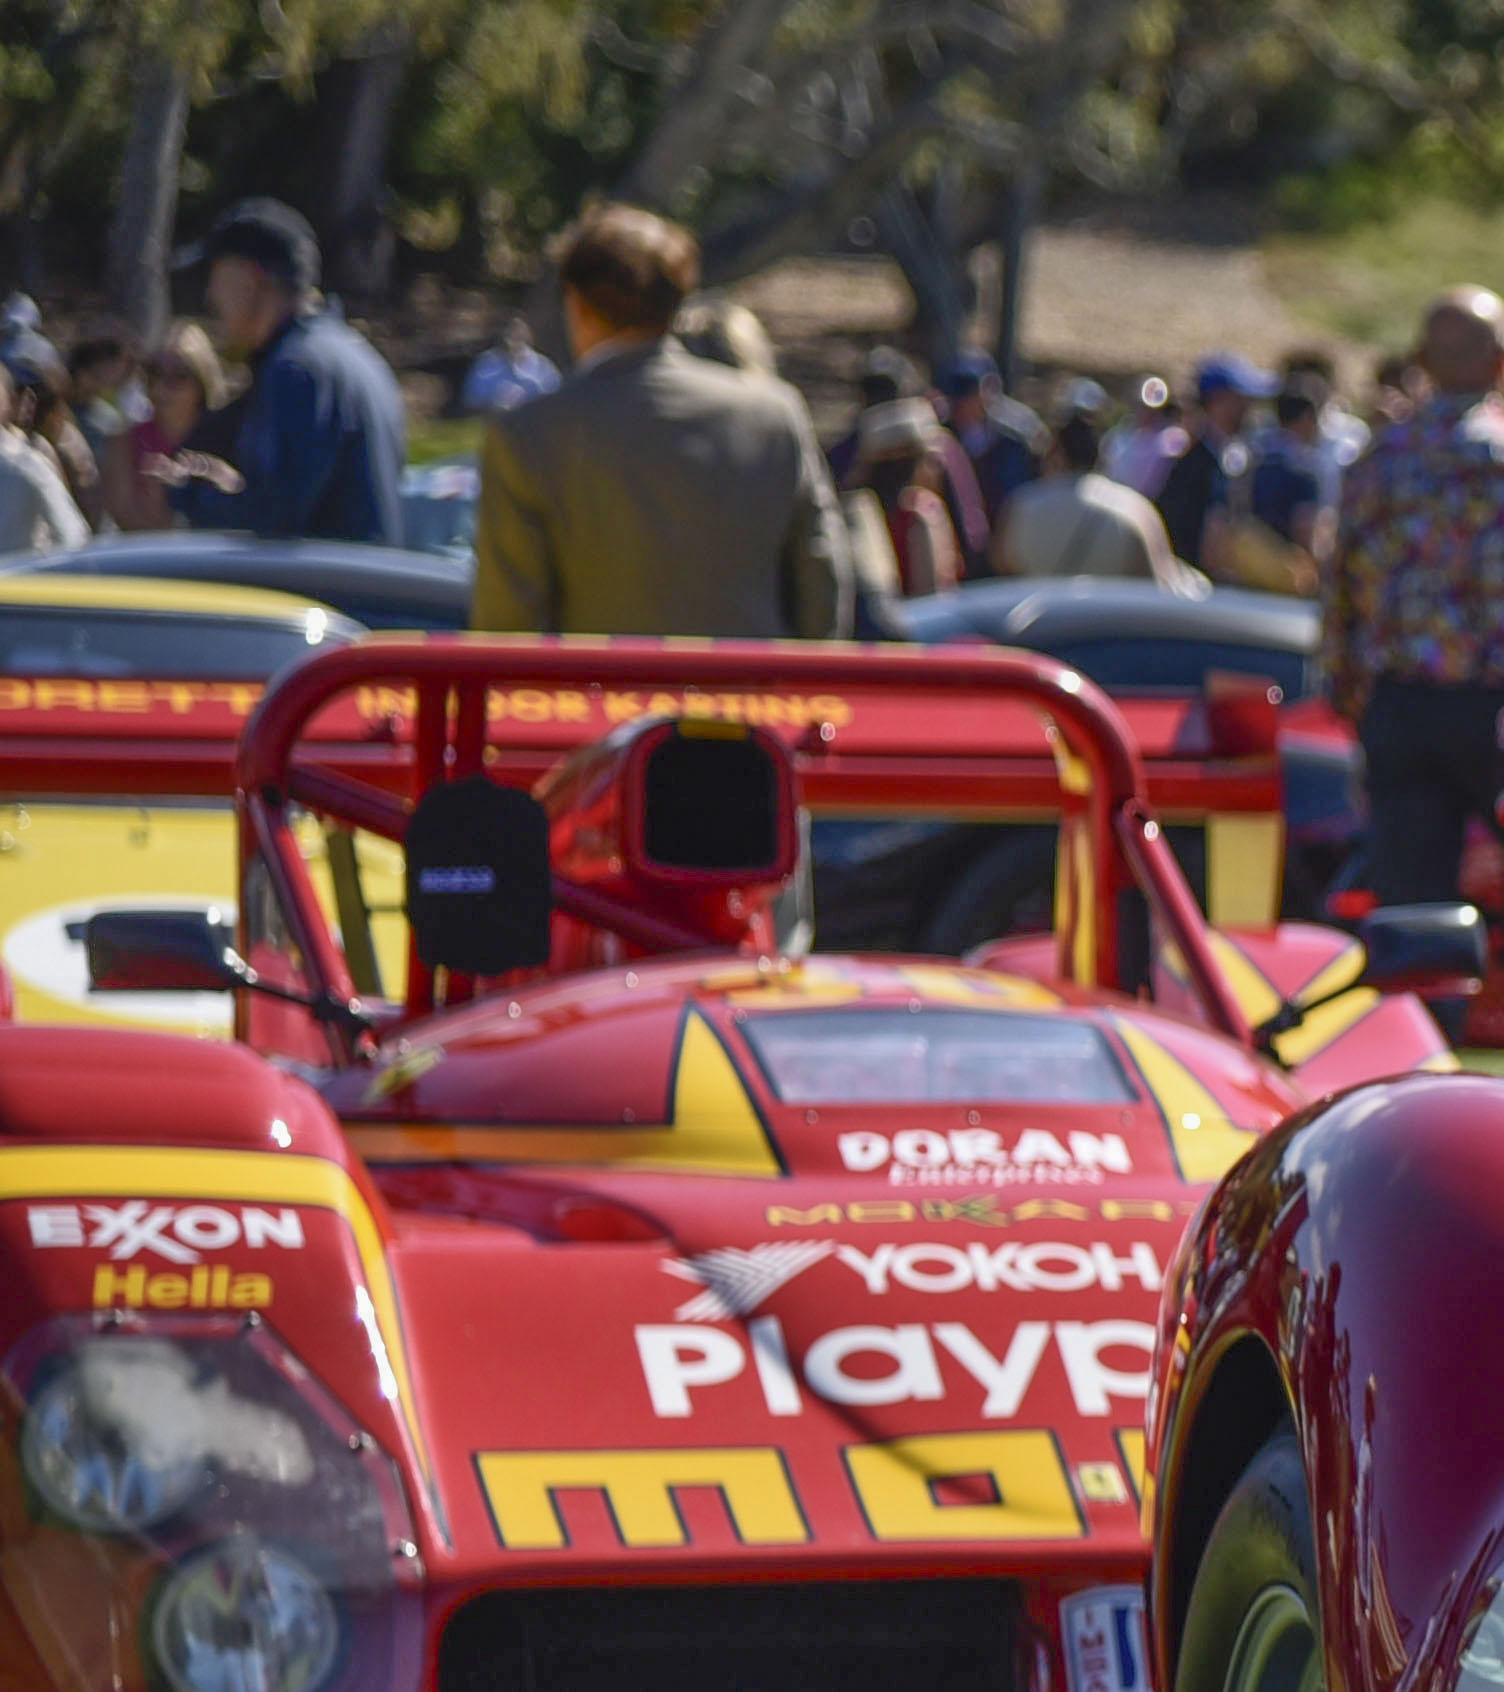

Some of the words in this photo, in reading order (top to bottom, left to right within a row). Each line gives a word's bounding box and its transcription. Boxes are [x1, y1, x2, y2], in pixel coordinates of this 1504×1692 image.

[356, 685, 590, 724] INOR
[838, 1128, 1133, 1174] DORAN
[27, 1200, 306, 1264] EXXON
[92, 1264, 272, 1309] Hella
